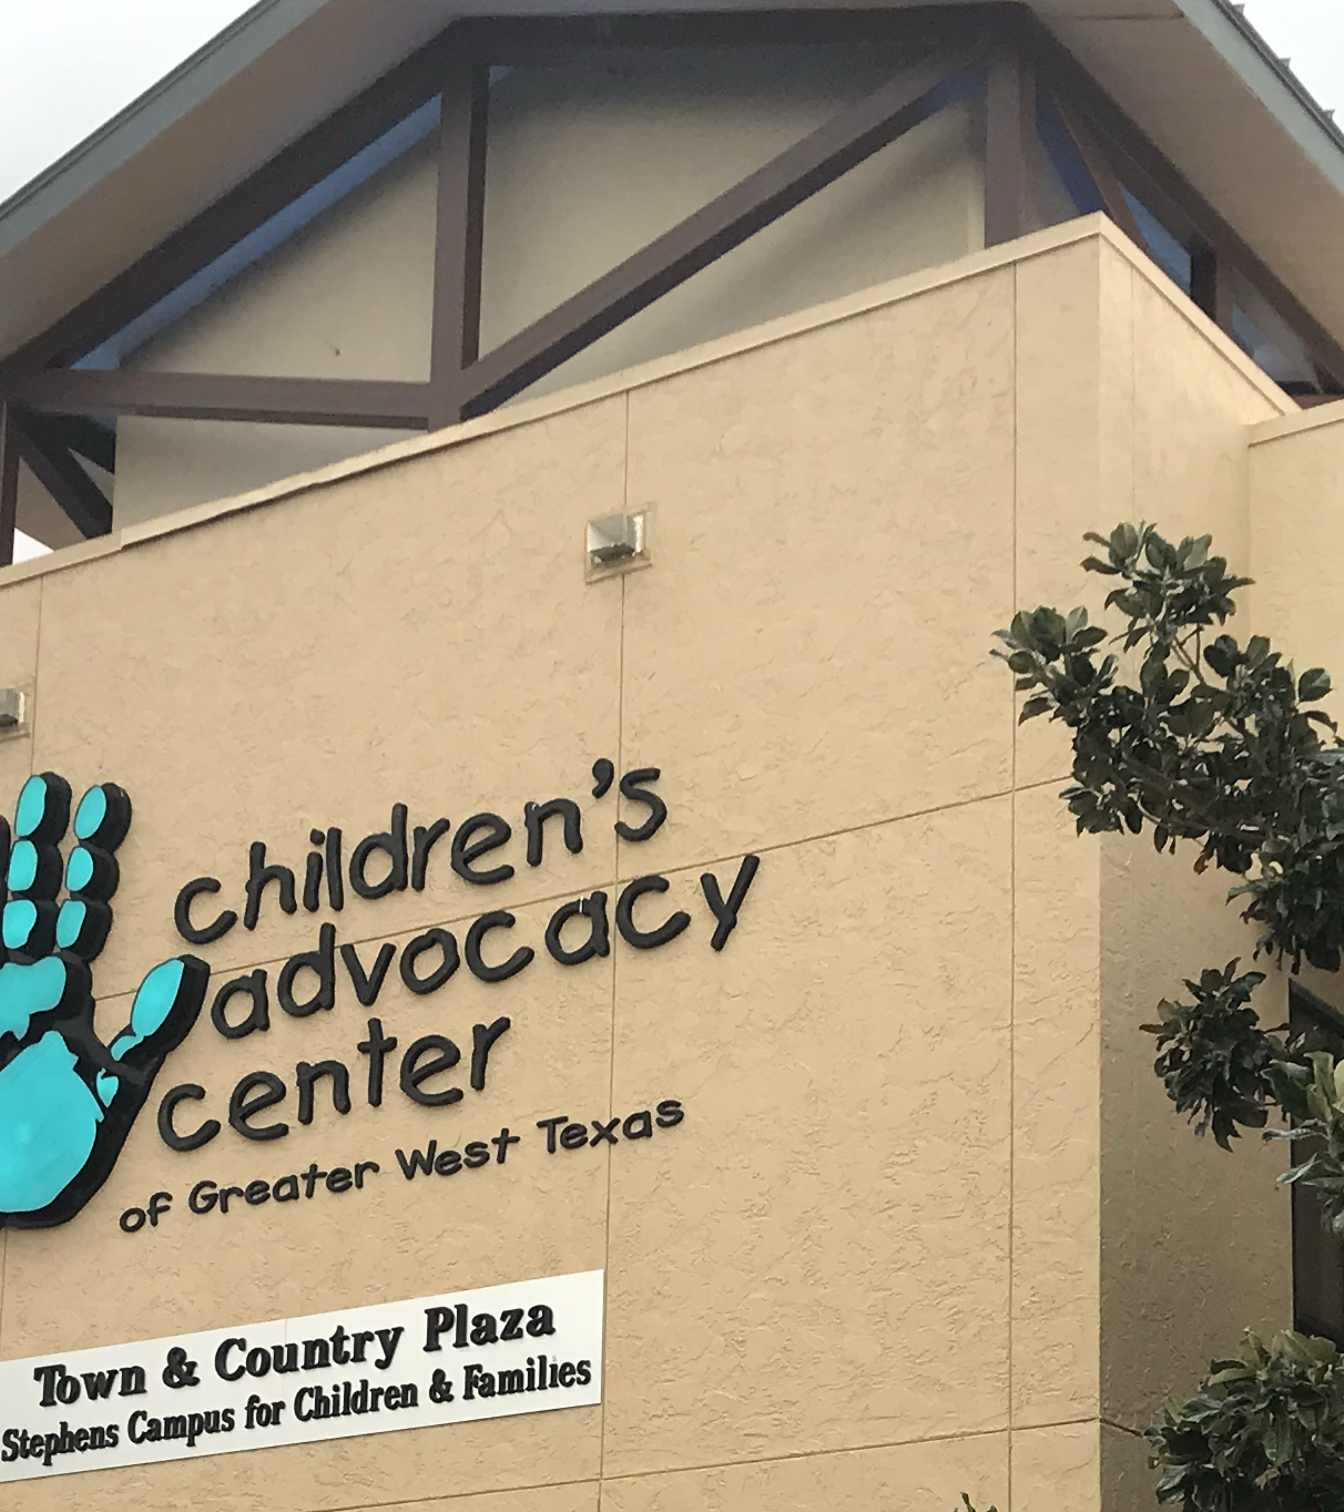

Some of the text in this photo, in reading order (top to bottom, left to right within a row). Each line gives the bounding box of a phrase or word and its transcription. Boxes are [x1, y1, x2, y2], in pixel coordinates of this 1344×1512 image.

[174, 758, 667, 944] children's
[210, 854, 760, 1039] advocacy
[157, 1017, 511, 1152] center
[119, 1098, 685, 1233] of Greater West Texas
[0, 1354, 592, 1465] Stephens Campus for Children & Families
[33, 1302, 556, 1407] Town & Country Plaza
